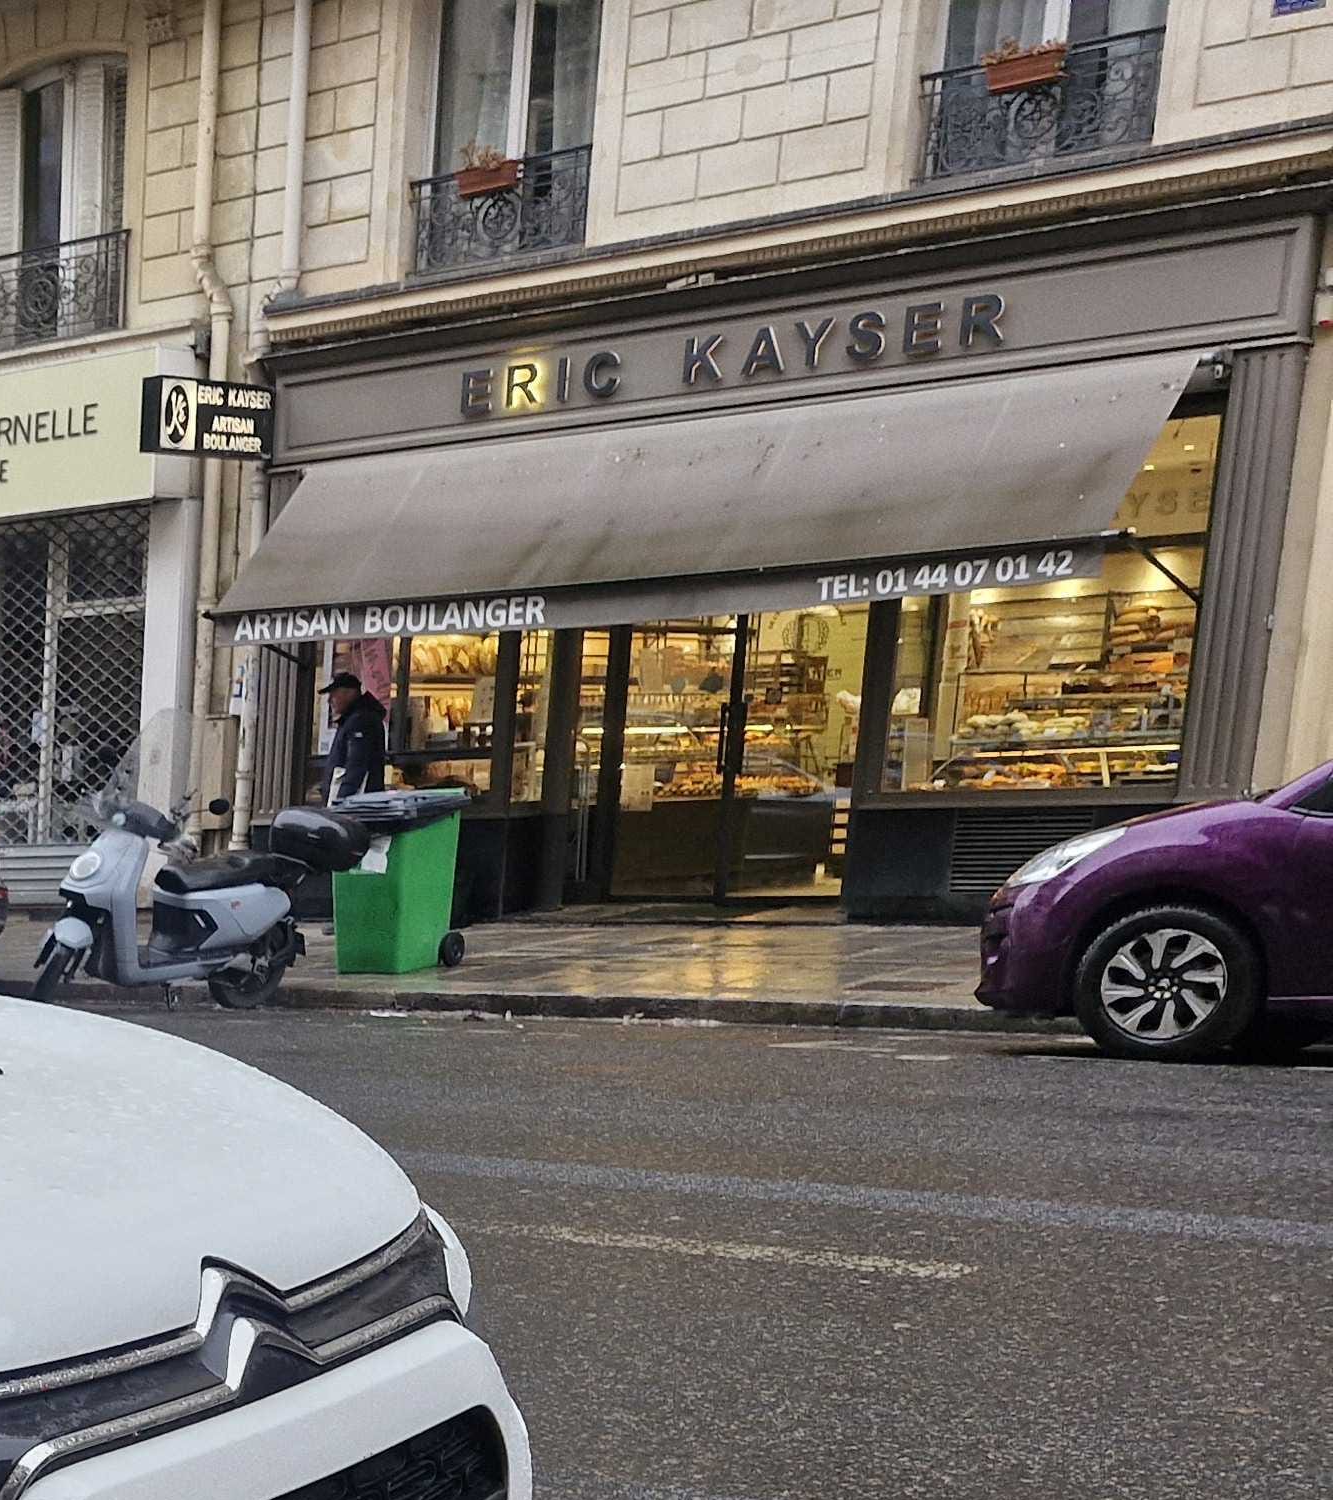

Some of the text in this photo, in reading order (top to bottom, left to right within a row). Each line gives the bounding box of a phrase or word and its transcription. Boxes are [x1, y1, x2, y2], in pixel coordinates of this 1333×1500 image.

[460, 293, 1006, 418] ERIC KAYSER
[197, 385, 271, 409] ERIC KAYSER
[212, 415, 254, 434] ARTISAN
[203, 432, 262, 452] BOULANGER
[817, 550, 1074, 601] TEL: 01 44 07 01 42
[234, 596, 546, 641] ARTISAN BOULANGER
